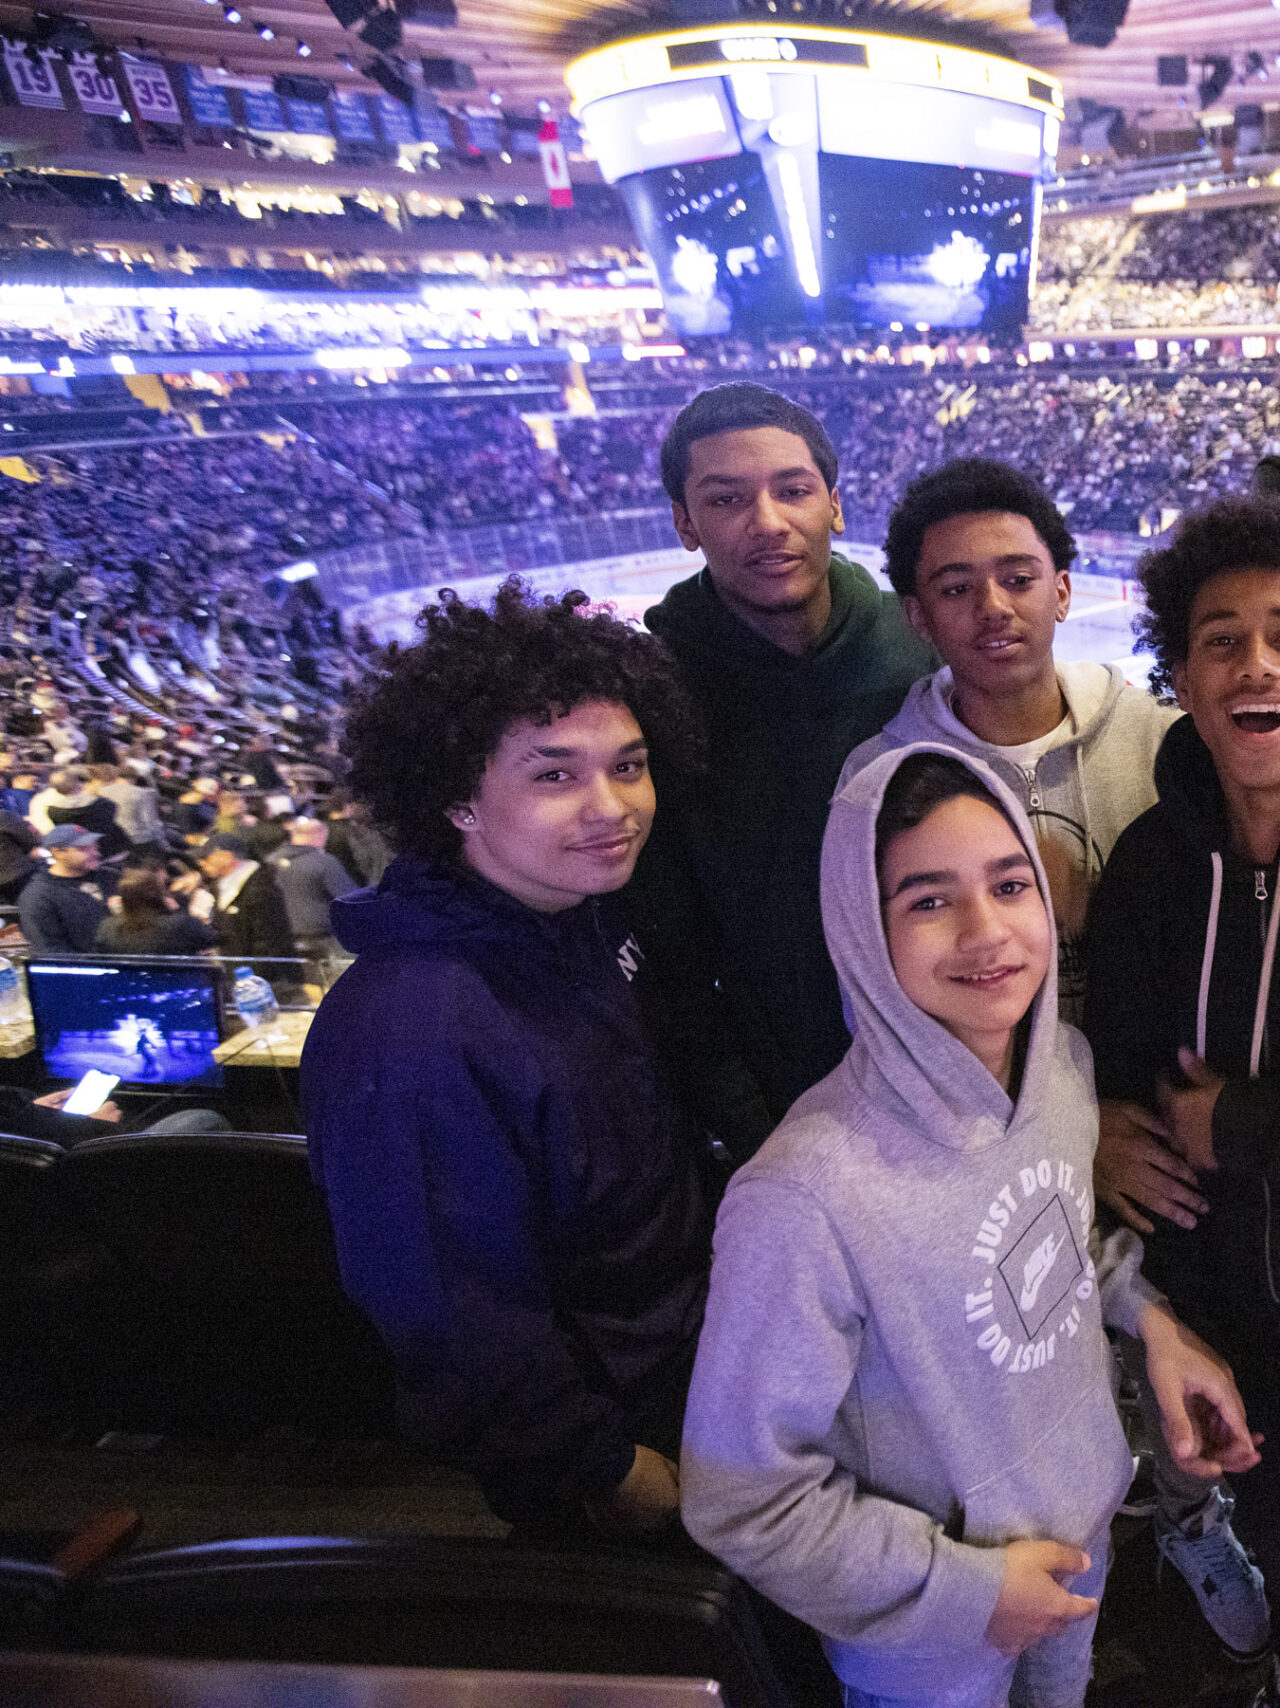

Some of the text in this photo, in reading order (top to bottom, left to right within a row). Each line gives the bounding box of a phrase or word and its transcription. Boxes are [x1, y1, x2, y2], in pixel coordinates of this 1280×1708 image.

[15, 62, 51, 94] 19
[75, 70, 114, 101] 30
[133, 79, 172, 109] 35
[1019, 1158, 1053, 1198] DO
[1057, 1159, 1075, 1197] IT.
[971, 1184, 1018, 1265] JUST
[964, 1276, 994, 1324] IT.
[976, 1322, 1012, 1368] DO
[1008, 1332, 1056, 1374] JUST
